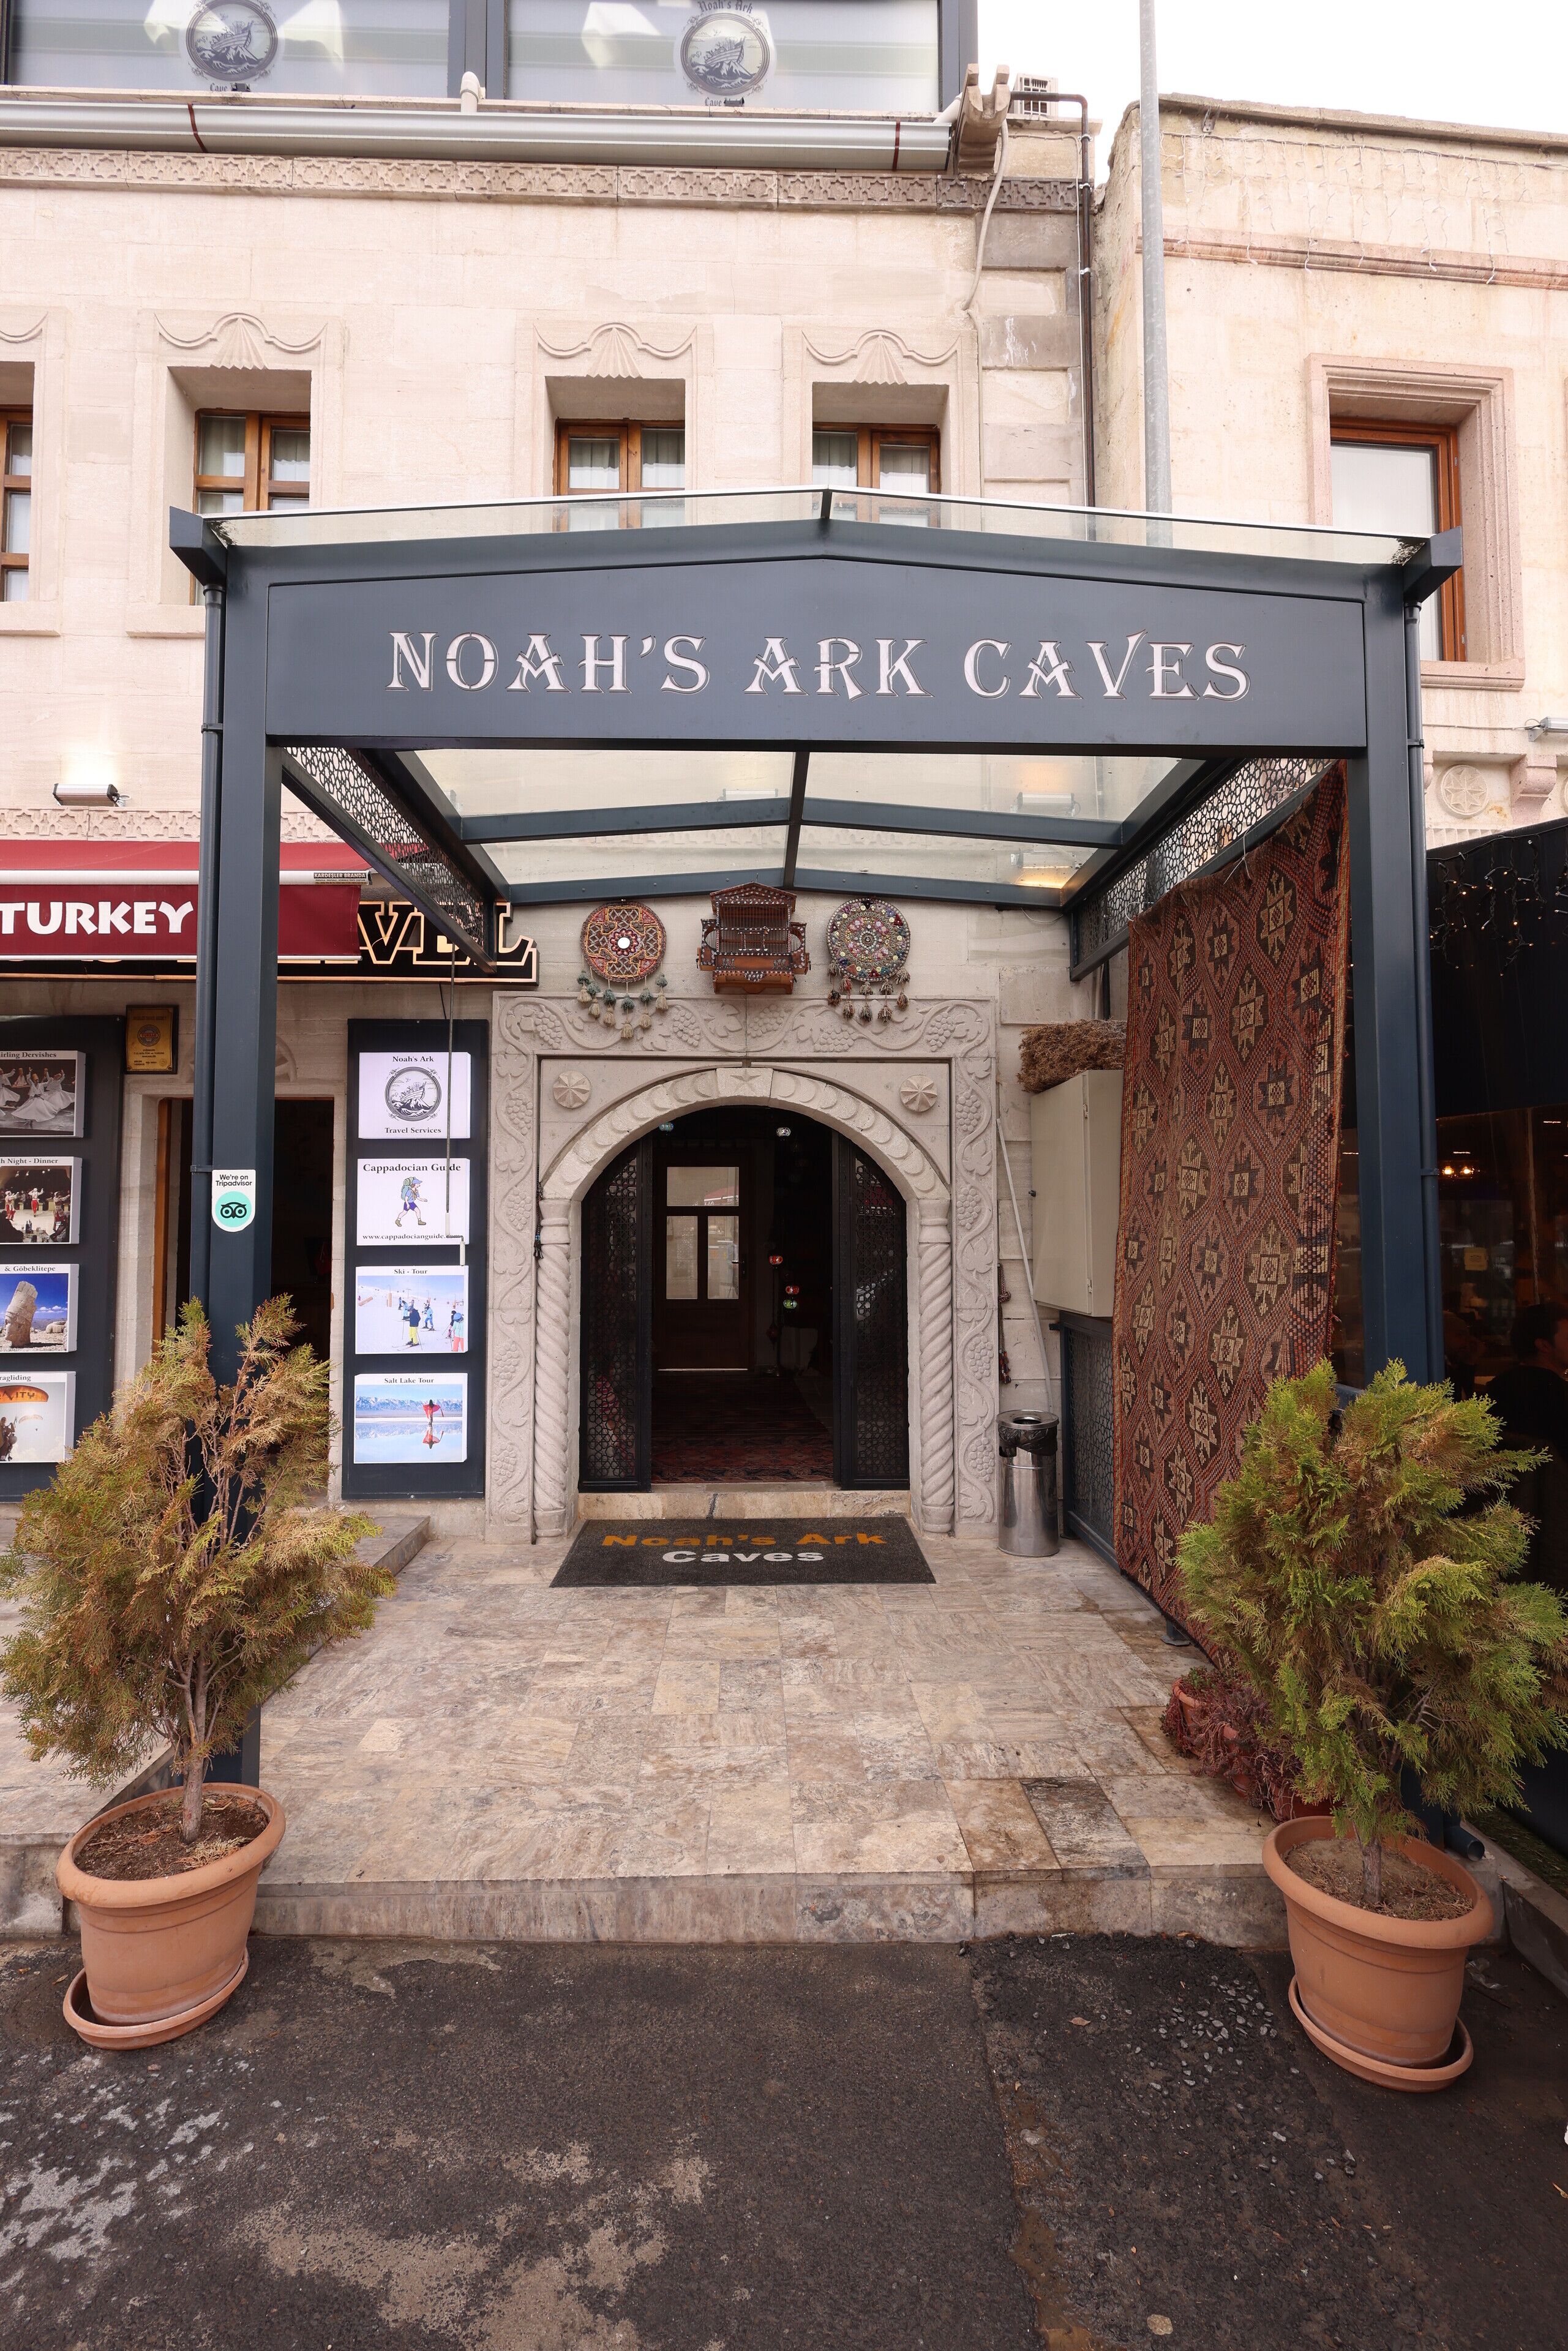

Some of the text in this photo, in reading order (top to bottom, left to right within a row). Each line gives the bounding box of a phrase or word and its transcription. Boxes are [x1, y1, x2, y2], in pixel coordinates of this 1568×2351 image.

[735, 0, 752, 13] Ark
[385, 629, 1251, 702] NOAH'S ARK CAVES
[0, 901, 194, 935] TURKEY
[363, 1163, 428, 1174] Cappadocian
[601, 1532, 887, 1547] Noah's Ark
[662, 1550, 824, 1563] Caves
